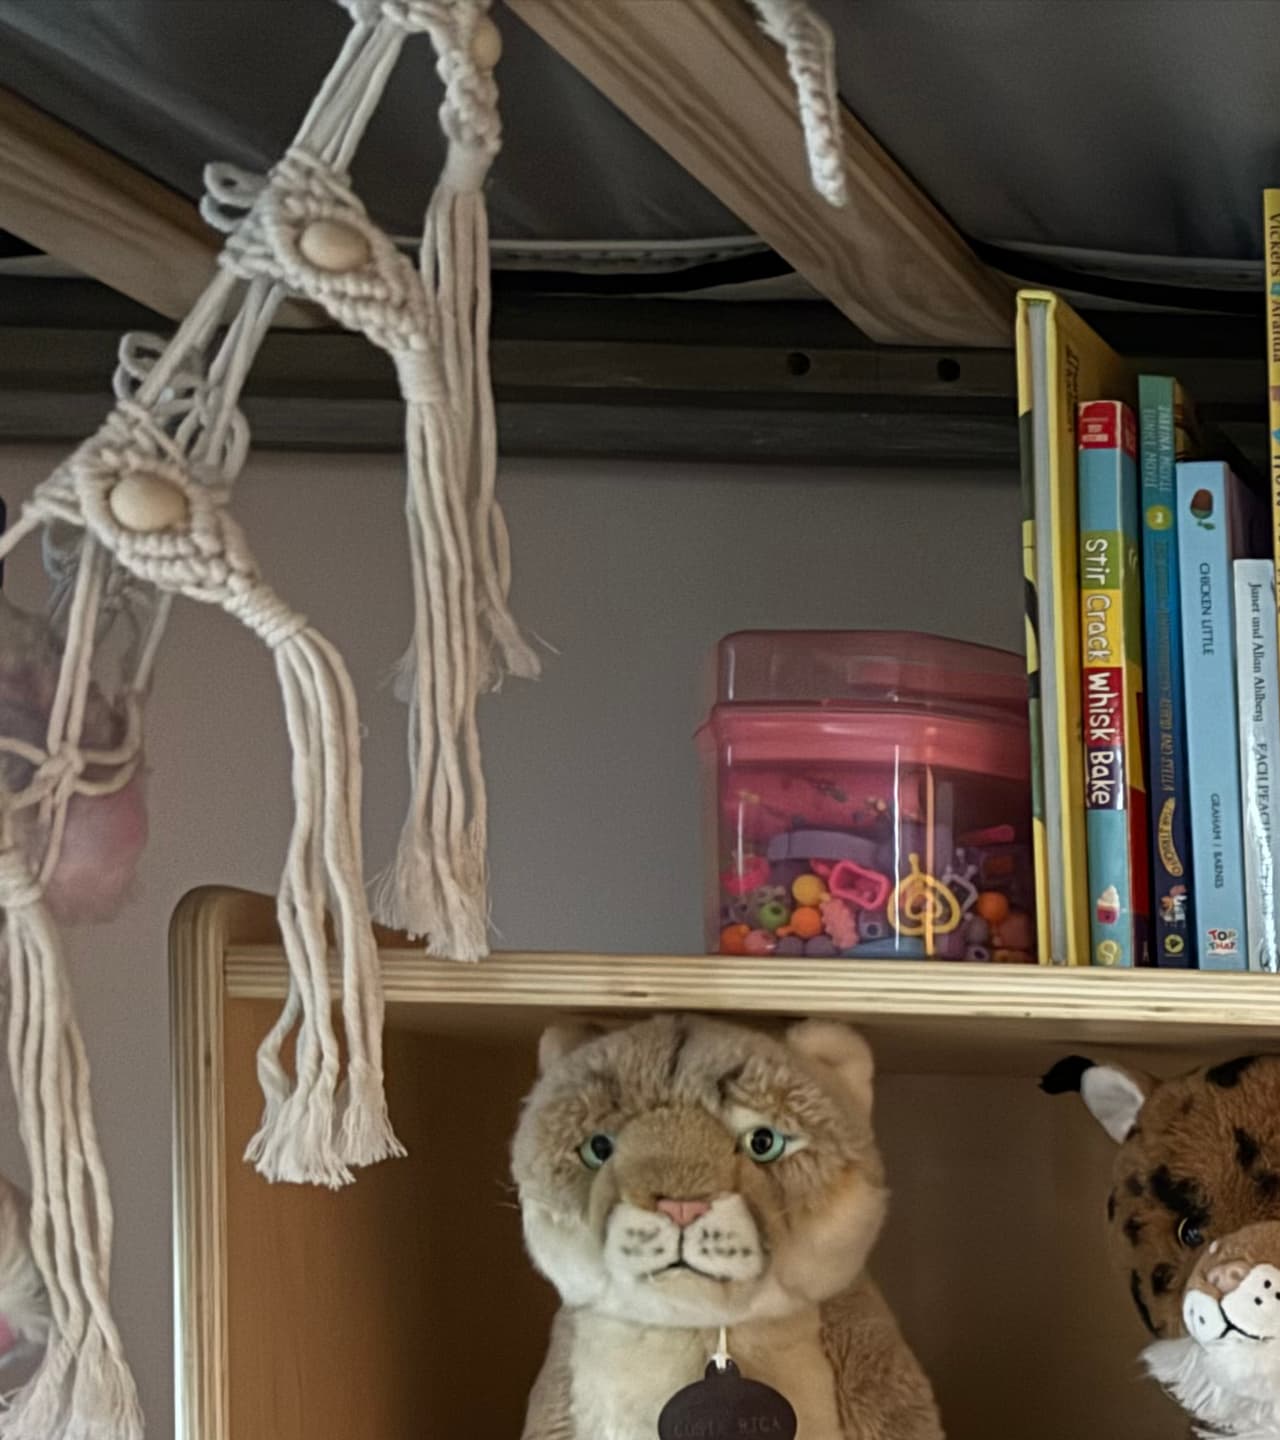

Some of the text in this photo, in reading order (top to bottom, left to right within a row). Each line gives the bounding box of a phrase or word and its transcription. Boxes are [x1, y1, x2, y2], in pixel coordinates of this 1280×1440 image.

[1085, 539, 1118, 805] Stir Crack whisk Bake
[1199, 563, 1214, 655] CHICKEN LITTLE
